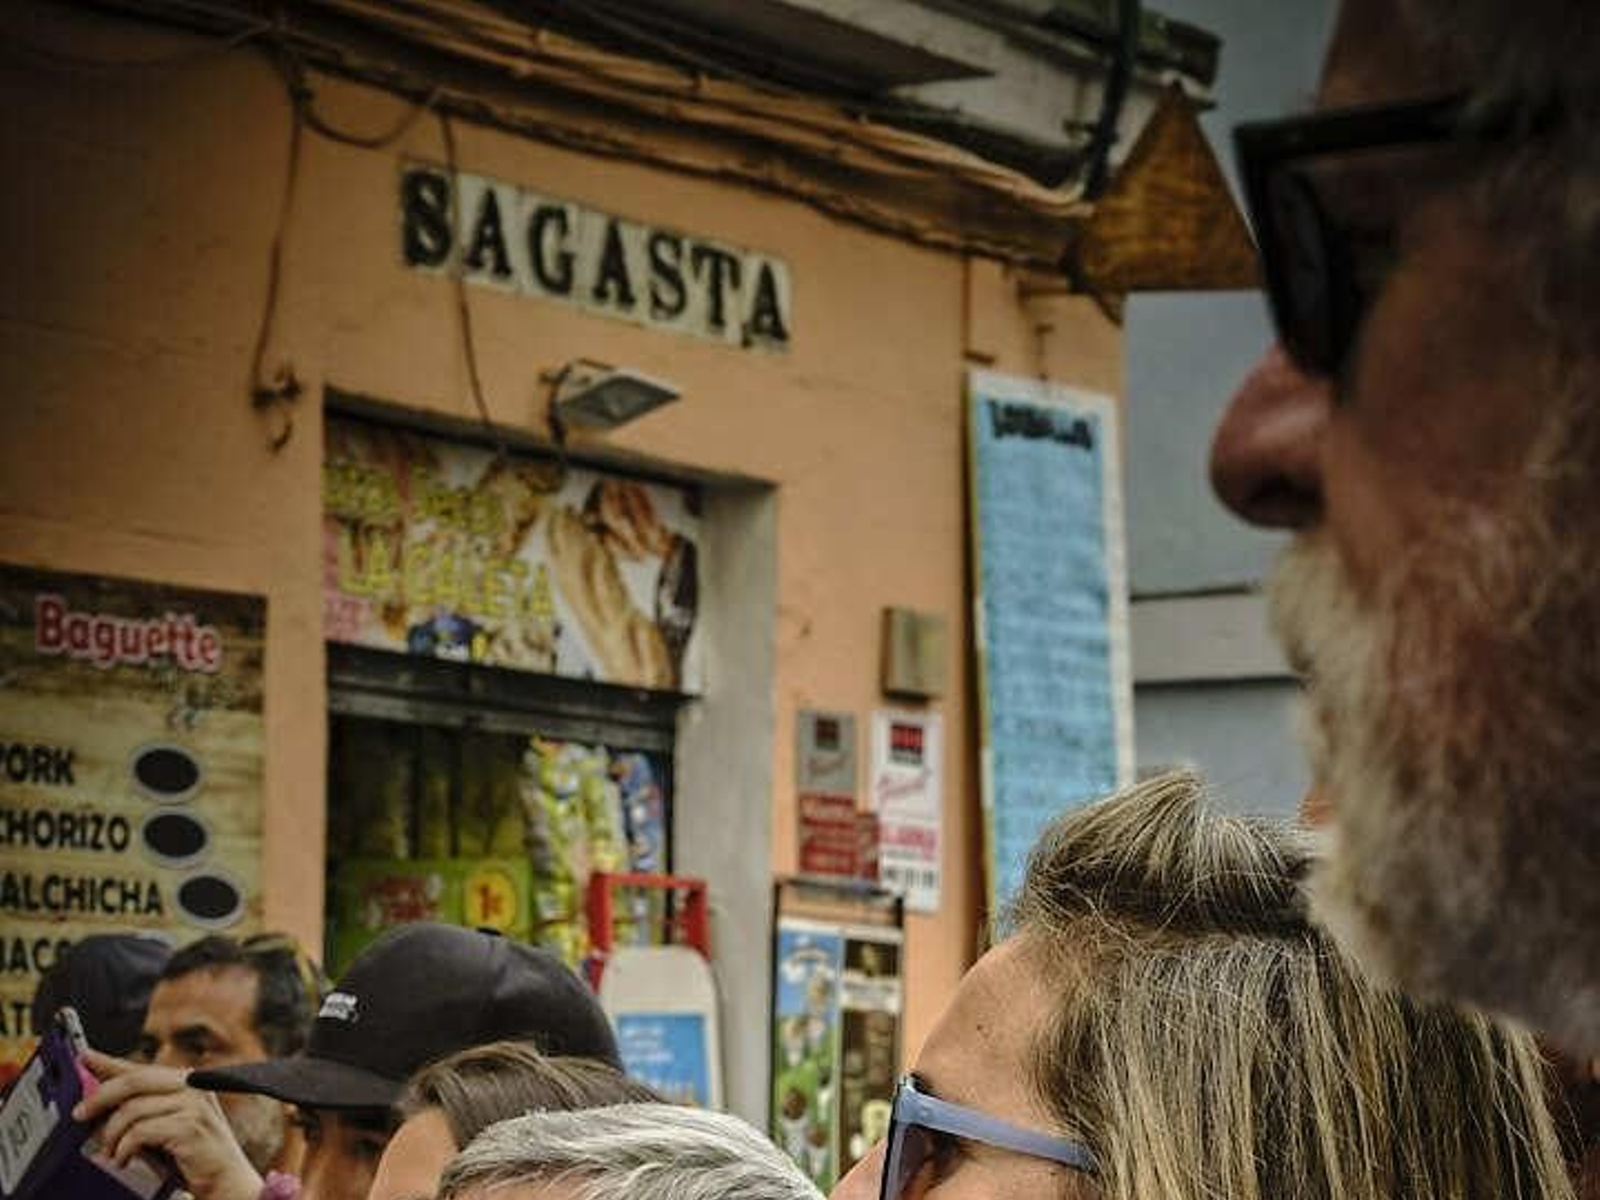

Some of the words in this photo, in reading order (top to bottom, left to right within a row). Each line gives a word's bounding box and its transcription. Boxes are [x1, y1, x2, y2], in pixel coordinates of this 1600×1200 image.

[403, 169, 790, 348] SAGASTA
[35, 597, 220, 669] Baguette
[0, 742, 75, 786] ORK
[0, 809, 131, 854] HORIZO
[0, 872, 164, 915] ALCHICHA
